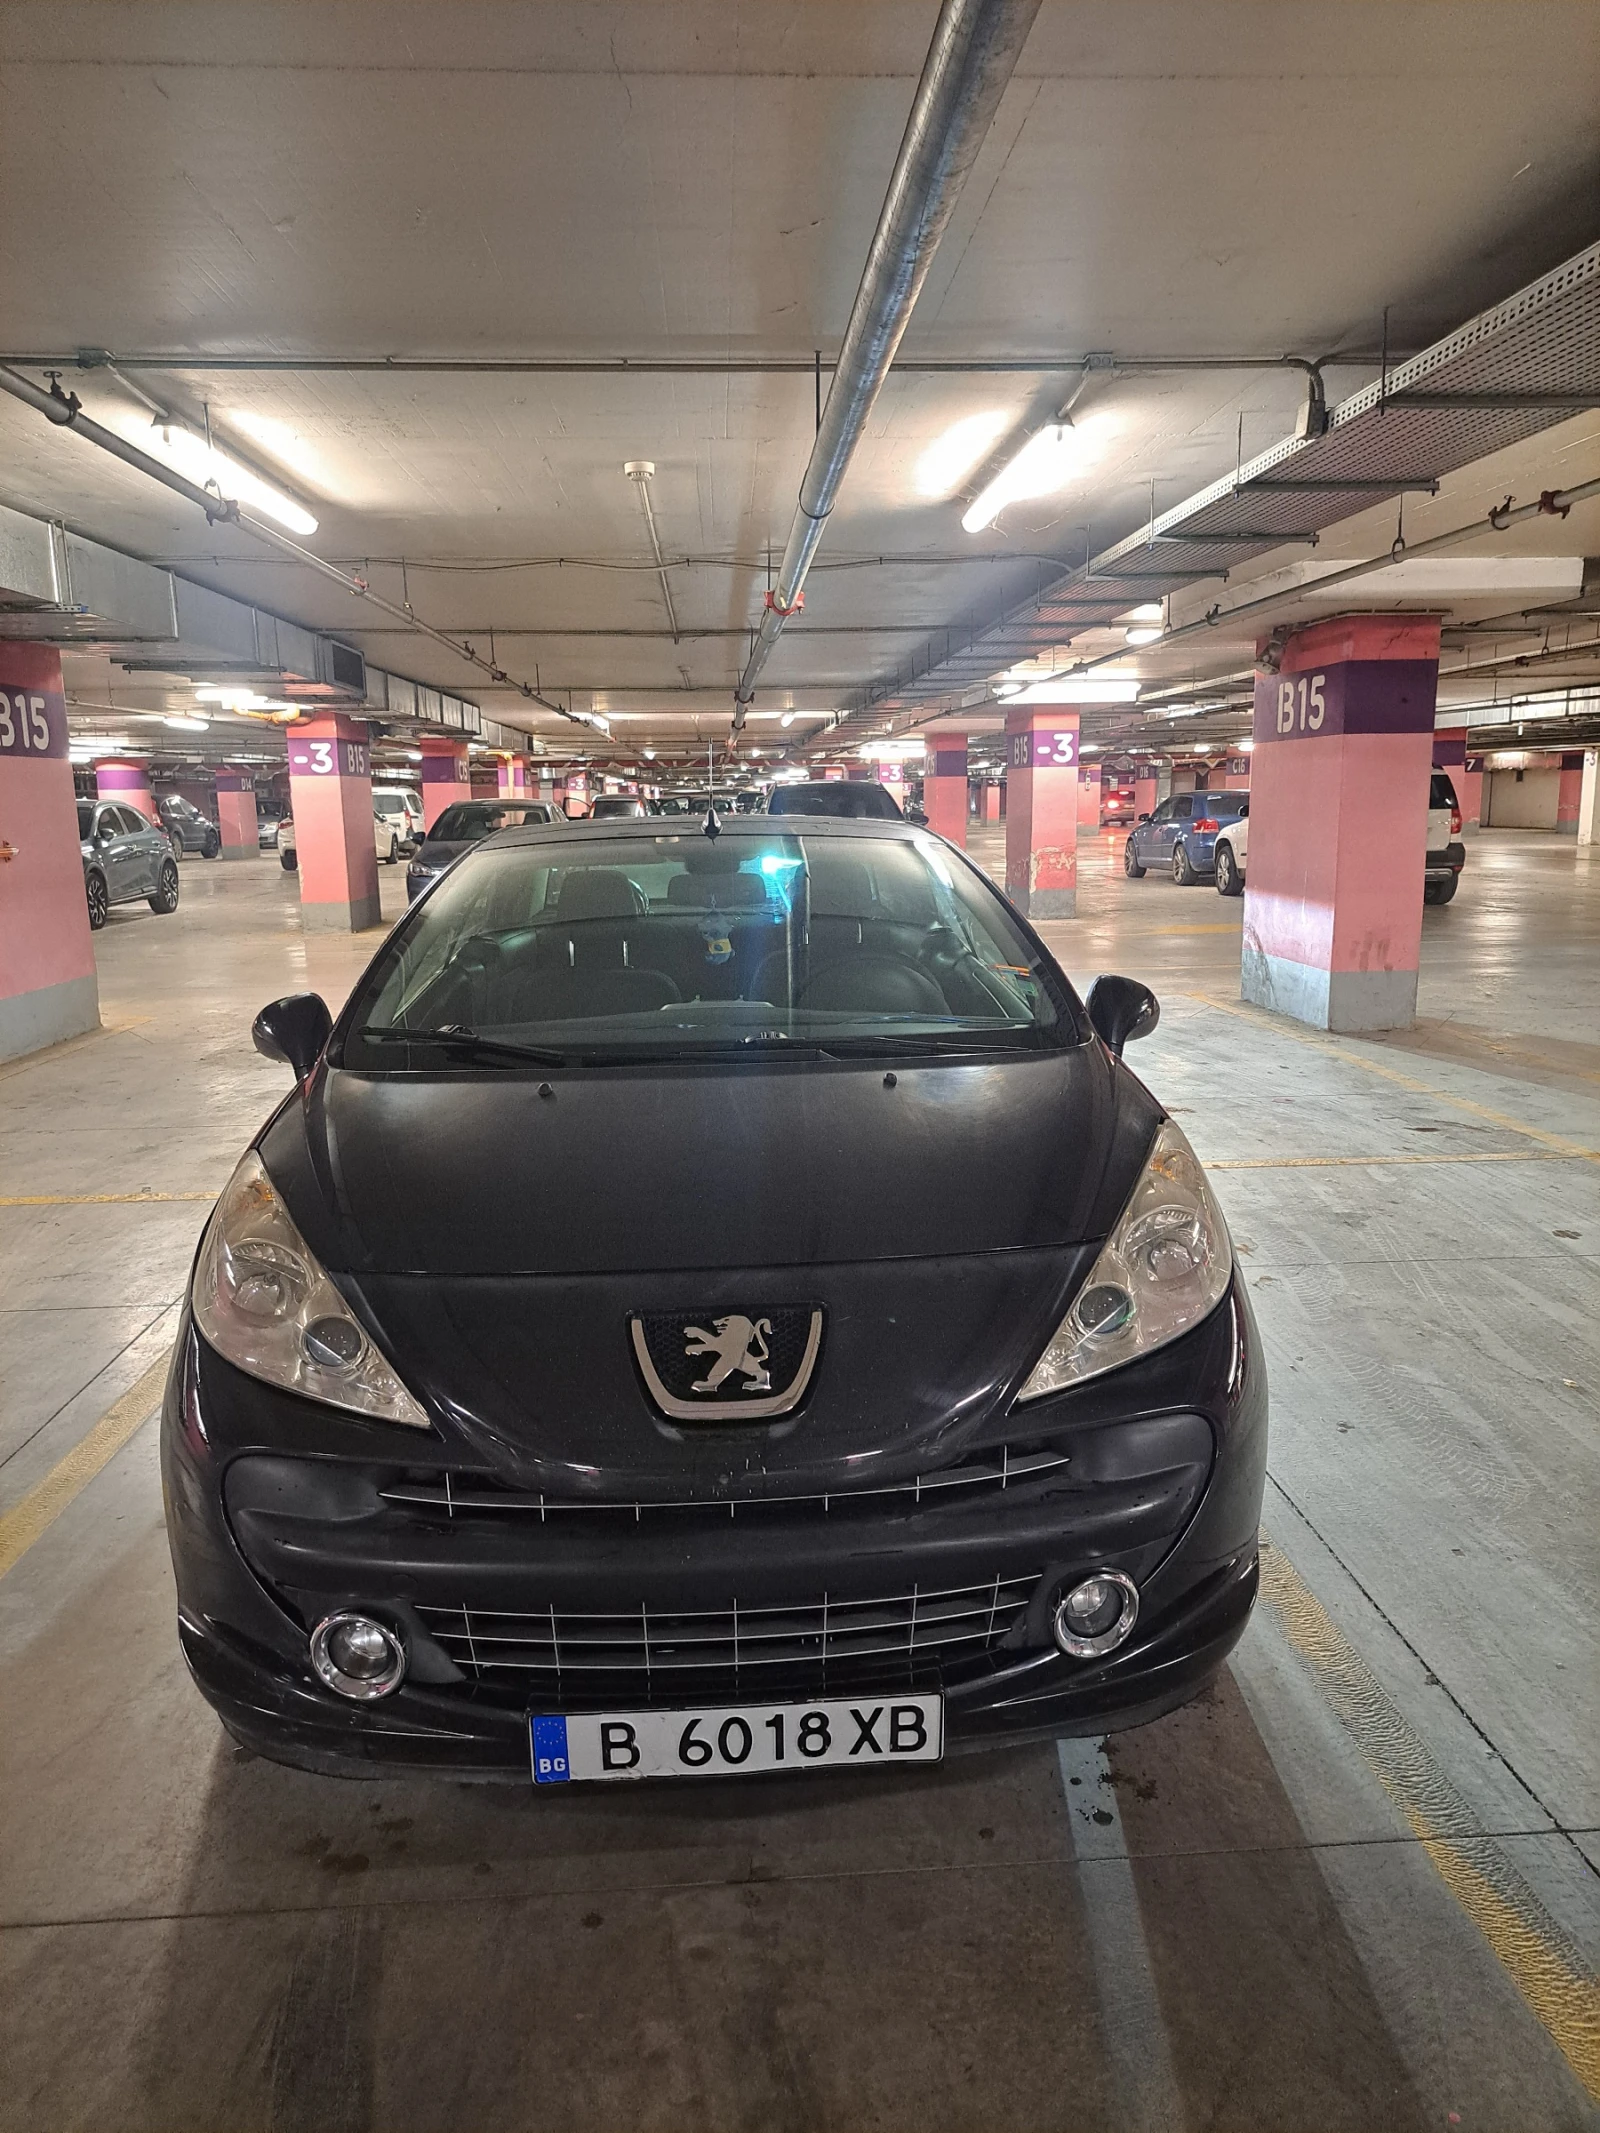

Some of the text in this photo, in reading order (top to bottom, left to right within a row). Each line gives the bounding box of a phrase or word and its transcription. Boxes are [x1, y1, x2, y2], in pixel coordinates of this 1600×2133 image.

[1277, 675, 1326, 733] B15
[0, 692, 49, 750] B15
[294, 743, 333, 773] -3
[347, 744, 365, 773] B15
[1014, 736, 1028, 765] B15
[1037, 733, 1073, 763] -3
[881, 765, 901, 781] -3
[1232, 758, 1246, 773] C16
[570, 778, 584, 790] -3
[600, 1705, 928, 1771] B 6018 XB
[539, 1757, 566, 1774] BG
